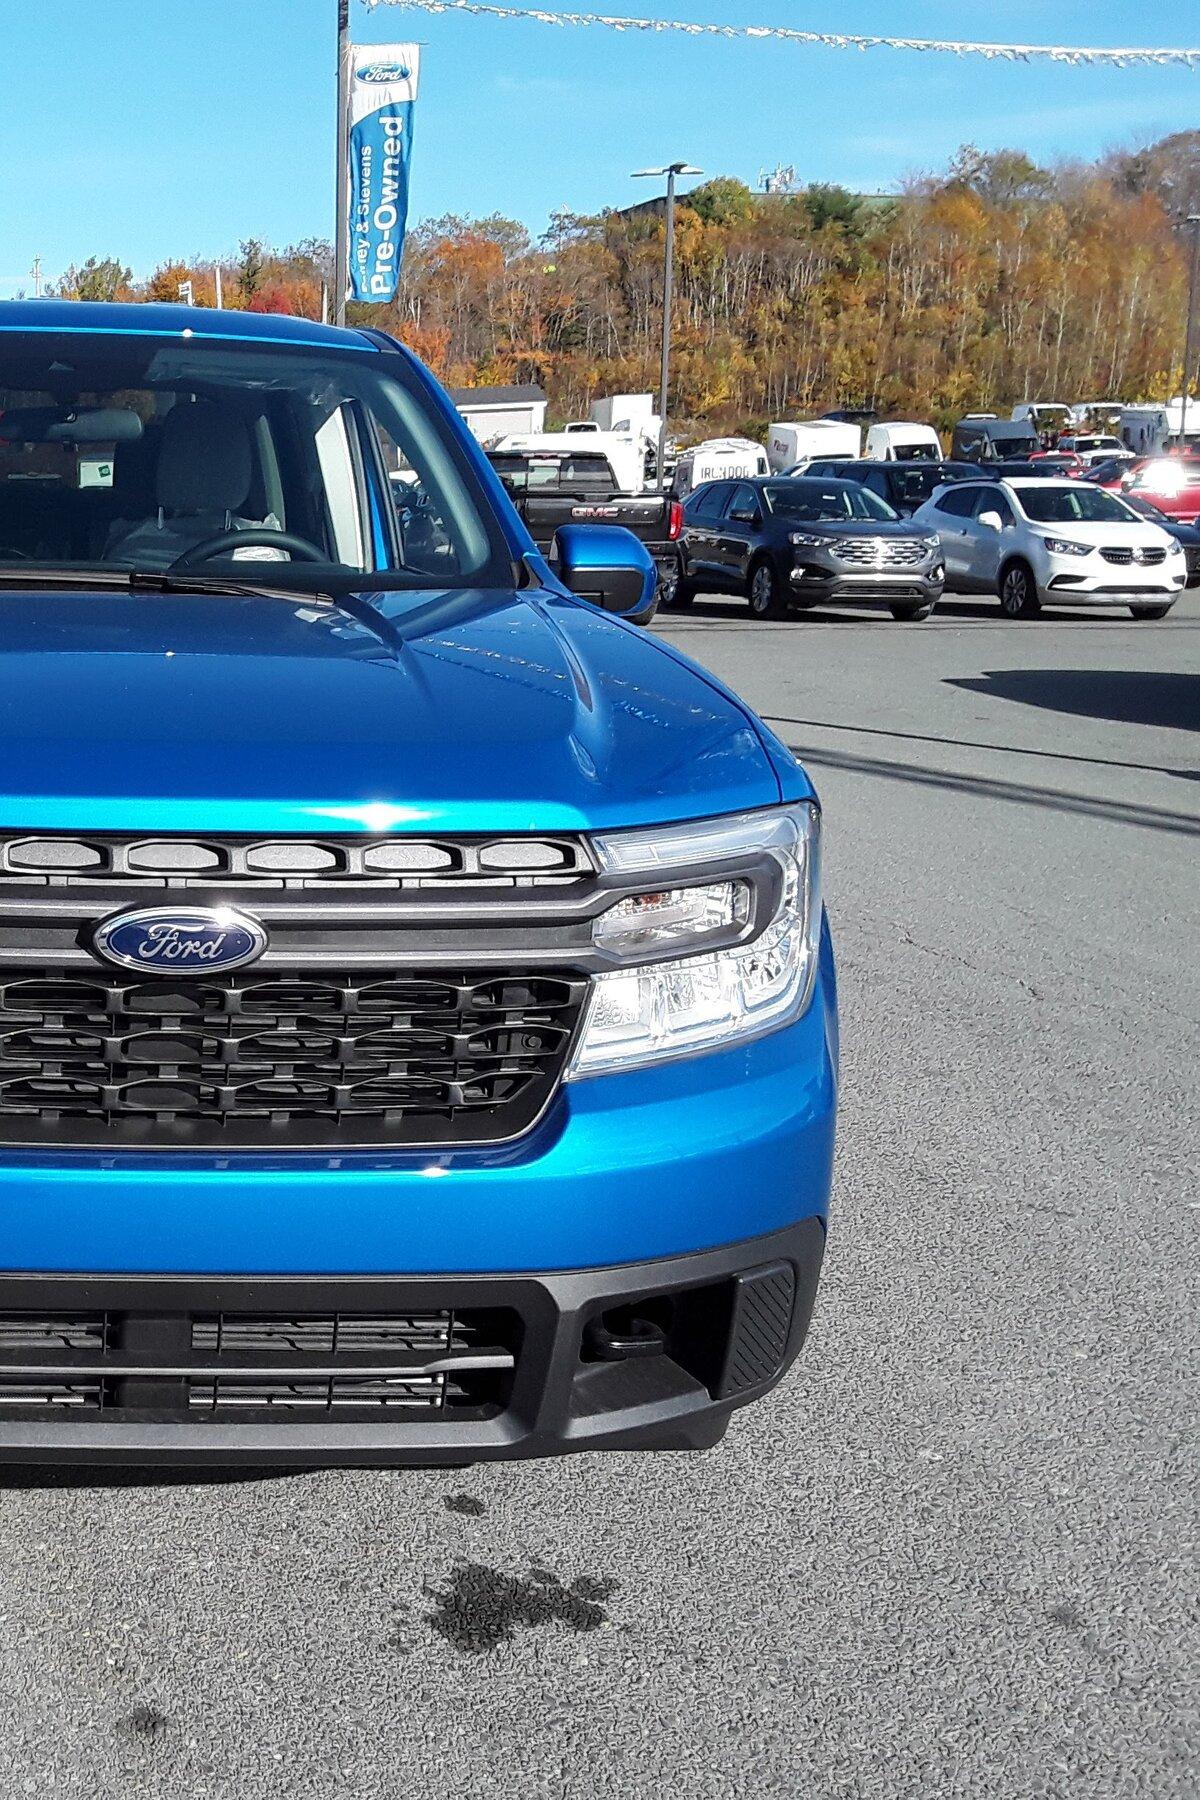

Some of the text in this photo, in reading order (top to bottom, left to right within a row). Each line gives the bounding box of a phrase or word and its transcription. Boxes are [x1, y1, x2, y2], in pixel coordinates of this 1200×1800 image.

[364, 64, 402, 81] Ford
[357, 145, 372, 215] Stevens
[370, 116, 403, 295] Pre-Owned
[571, 506, 619, 518] GMC
[138, 923, 227, 959] Ford
